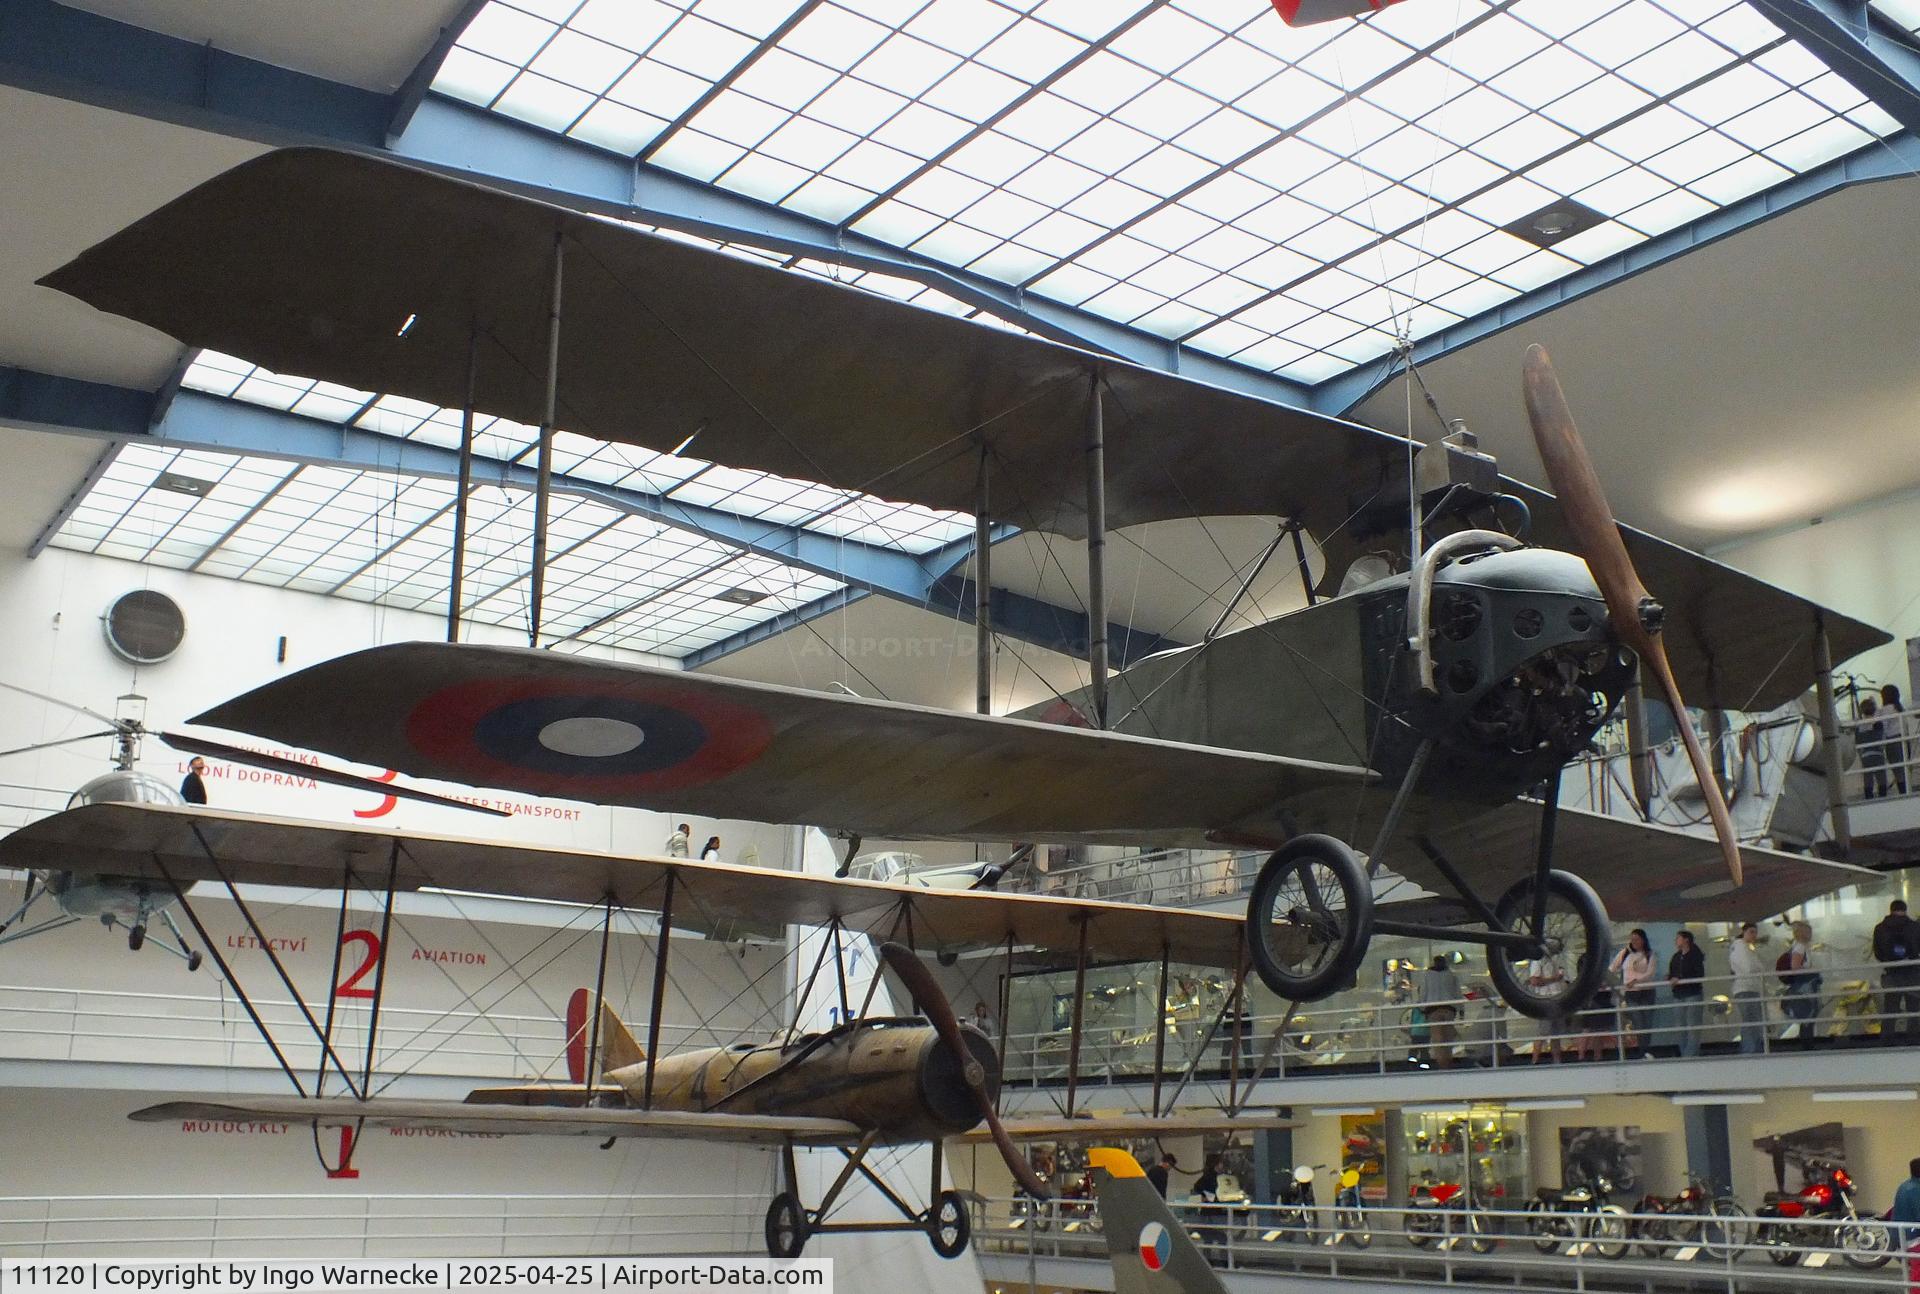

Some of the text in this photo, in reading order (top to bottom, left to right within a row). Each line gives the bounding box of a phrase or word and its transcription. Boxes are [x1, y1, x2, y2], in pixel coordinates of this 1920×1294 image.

[177, 762, 318, 790] LDNÍ DOPRAVA
[495, 800, 582, 821] TRANSPORT
[336, 929, 382, 998] 2
[411, 948, 487, 965] AVIATION
